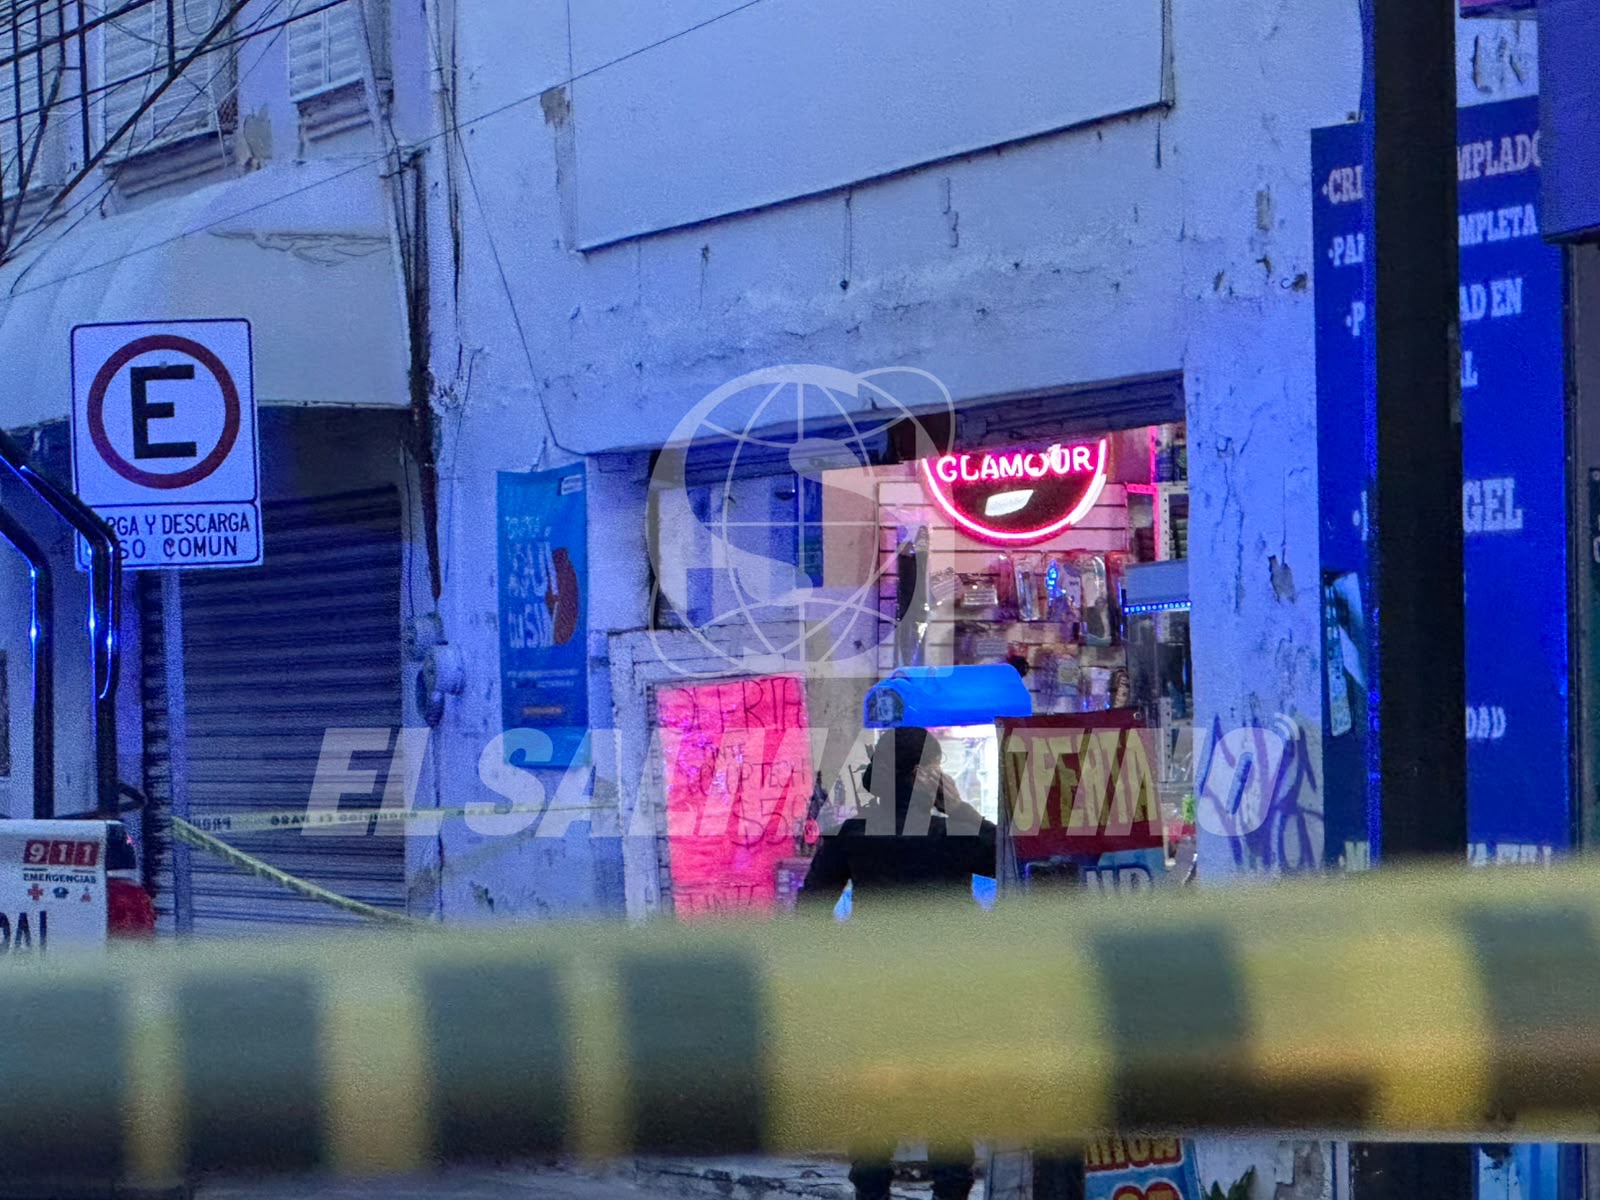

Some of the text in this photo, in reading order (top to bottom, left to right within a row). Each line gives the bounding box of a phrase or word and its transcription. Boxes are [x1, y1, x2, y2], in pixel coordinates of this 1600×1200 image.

[1458, 203, 1539, 246] MPLETA
[130, 364, 197, 459] E
[936, 444, 1094, 482] GLAMOUR
[145, 514, 156, 535] Y
[162, 512, 250, 535] DESCARGA
[119, 536, 238, 560] SO COMUN
[28, 842, 94, 865] 911
[23, 873, 97, 884] EMERGENCIAS
